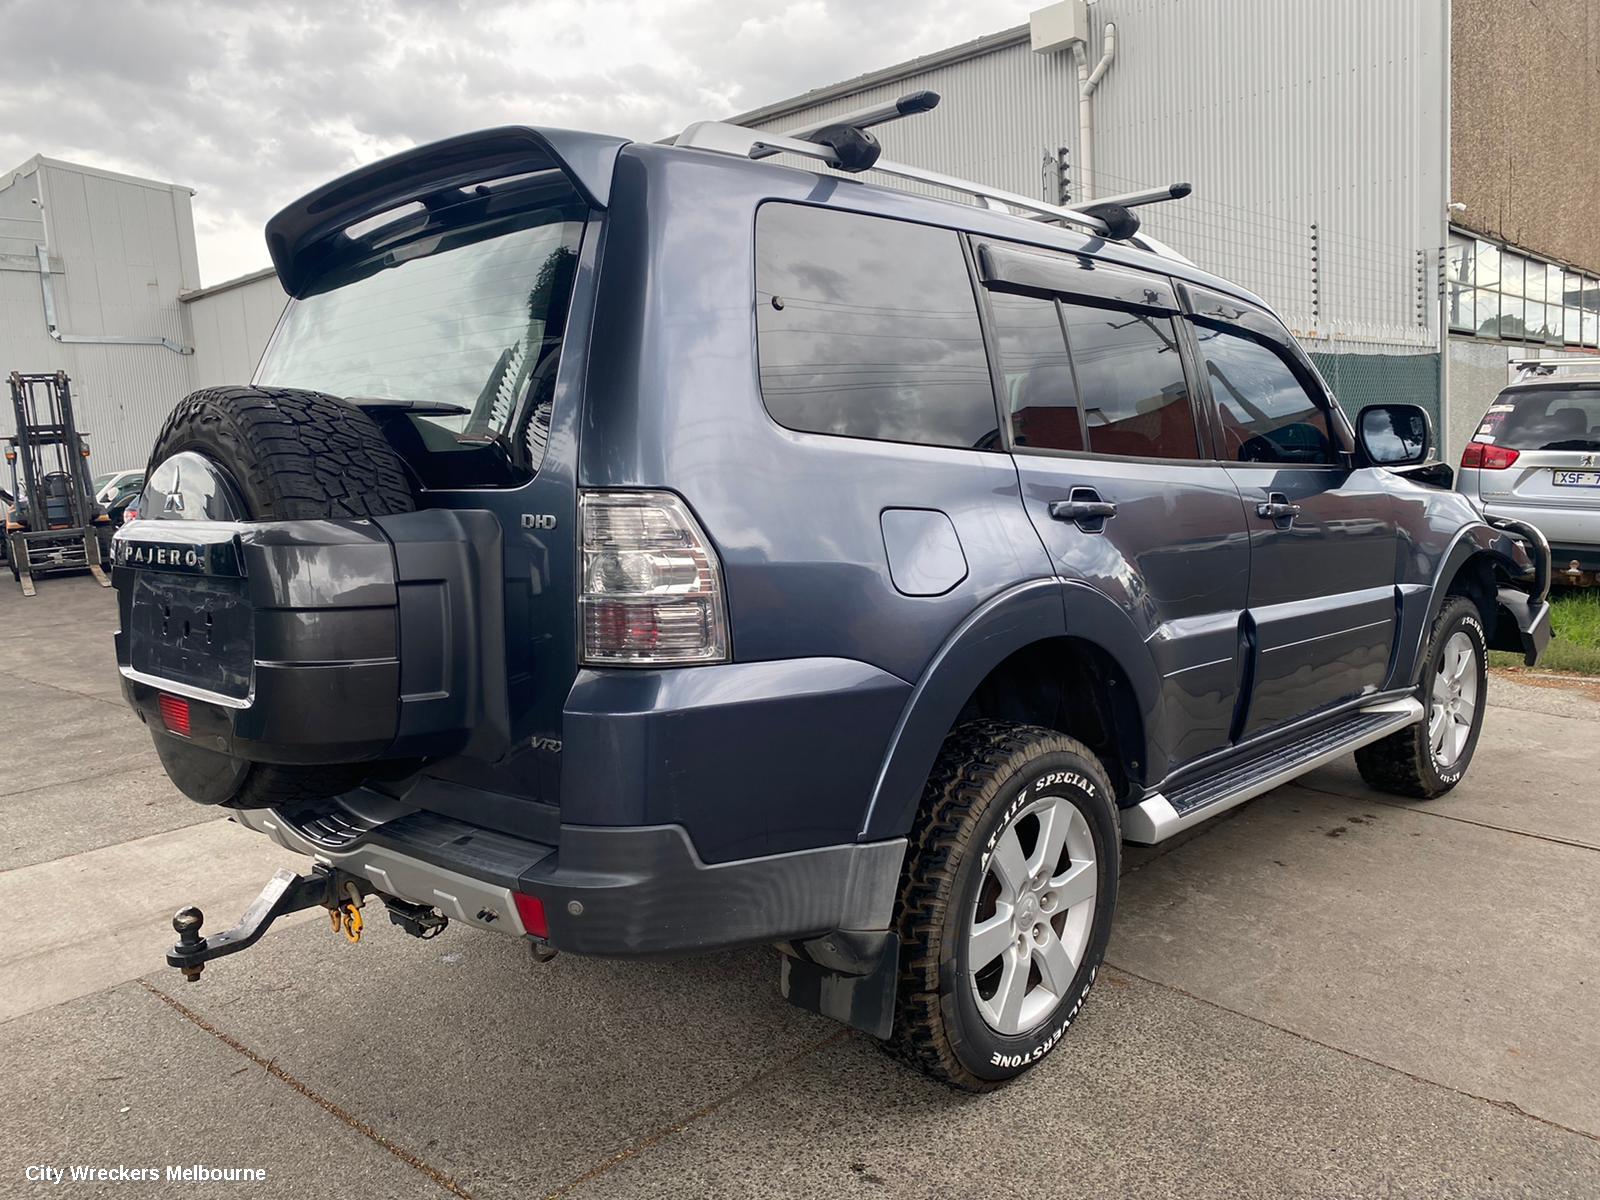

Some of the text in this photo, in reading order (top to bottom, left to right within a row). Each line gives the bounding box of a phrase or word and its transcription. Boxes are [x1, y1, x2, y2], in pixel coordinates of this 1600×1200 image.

[1560, 472, 1585, 483] XSF
[125, 546, 197, 567] PAJERO
[1035, 772, 1096, 797] SPECIAL
[990, 982, 1091, 1068] SILVERSTONE
